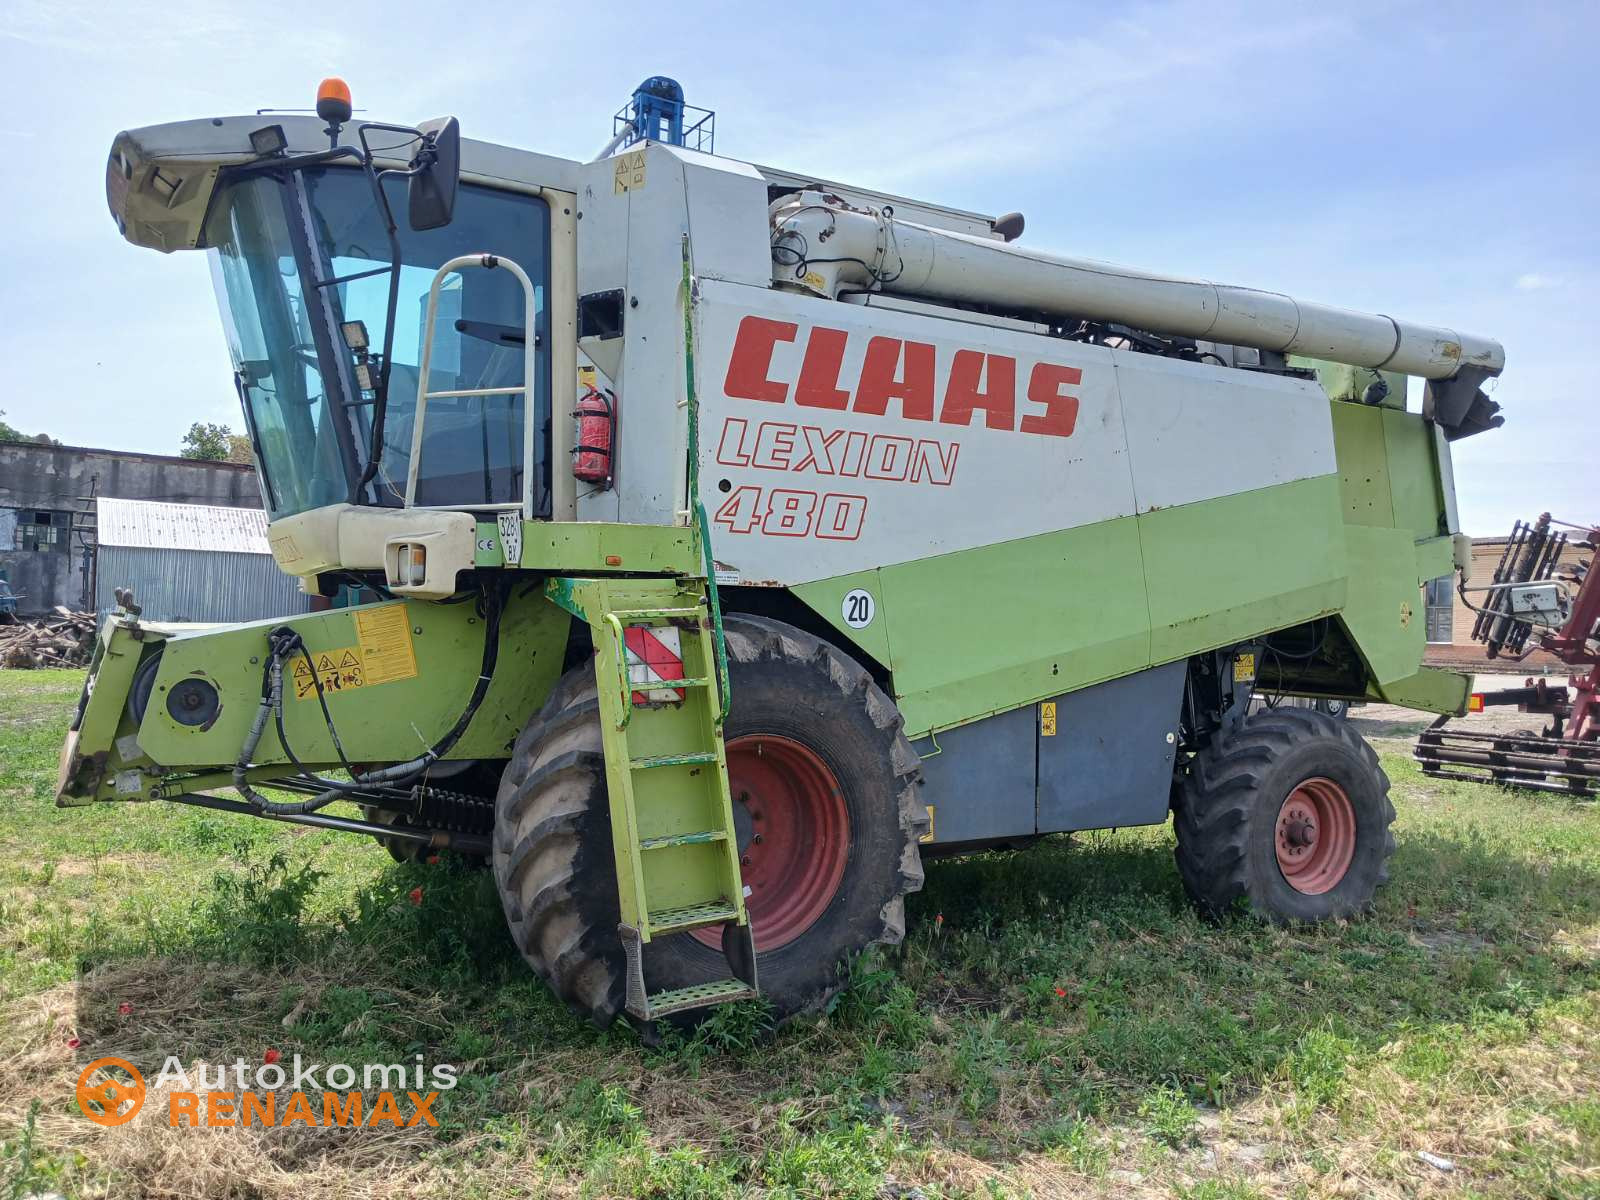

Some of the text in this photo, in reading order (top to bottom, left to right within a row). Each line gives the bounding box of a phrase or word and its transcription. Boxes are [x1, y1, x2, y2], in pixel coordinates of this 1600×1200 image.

[724, 315, 1083, 438] CLAAS
[716, 417, 960, 486] LEXION
[714, 485, 868, 541] 480
[848, 595, 869, 623] 20
